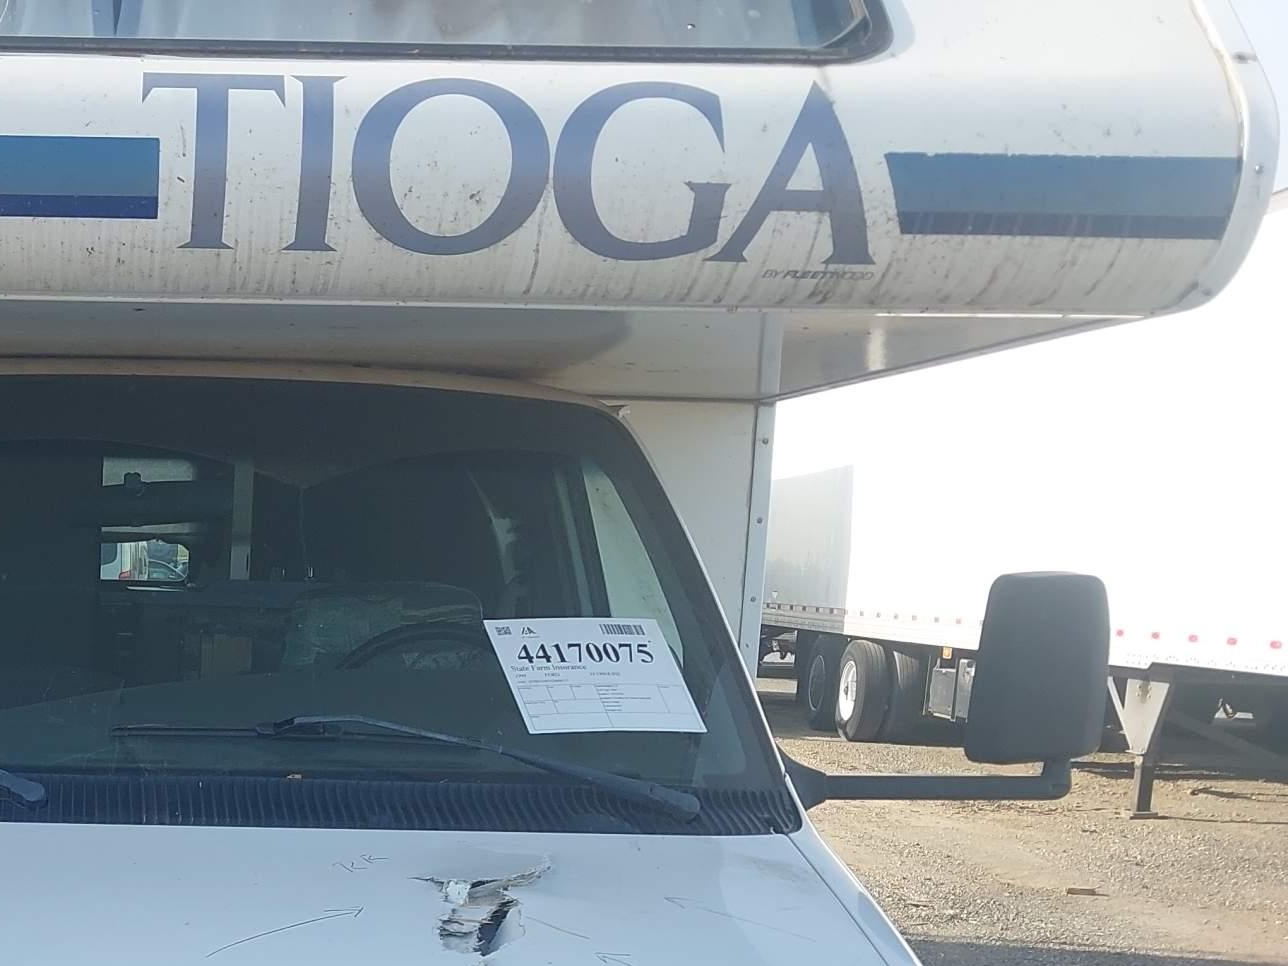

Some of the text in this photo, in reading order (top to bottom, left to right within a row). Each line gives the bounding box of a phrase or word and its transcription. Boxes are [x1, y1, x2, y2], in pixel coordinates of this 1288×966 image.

[143, 73, 877, 265] TIOGA
[762, 269, 783, 279] BY
[518, 642, 654, 664] 44170075
